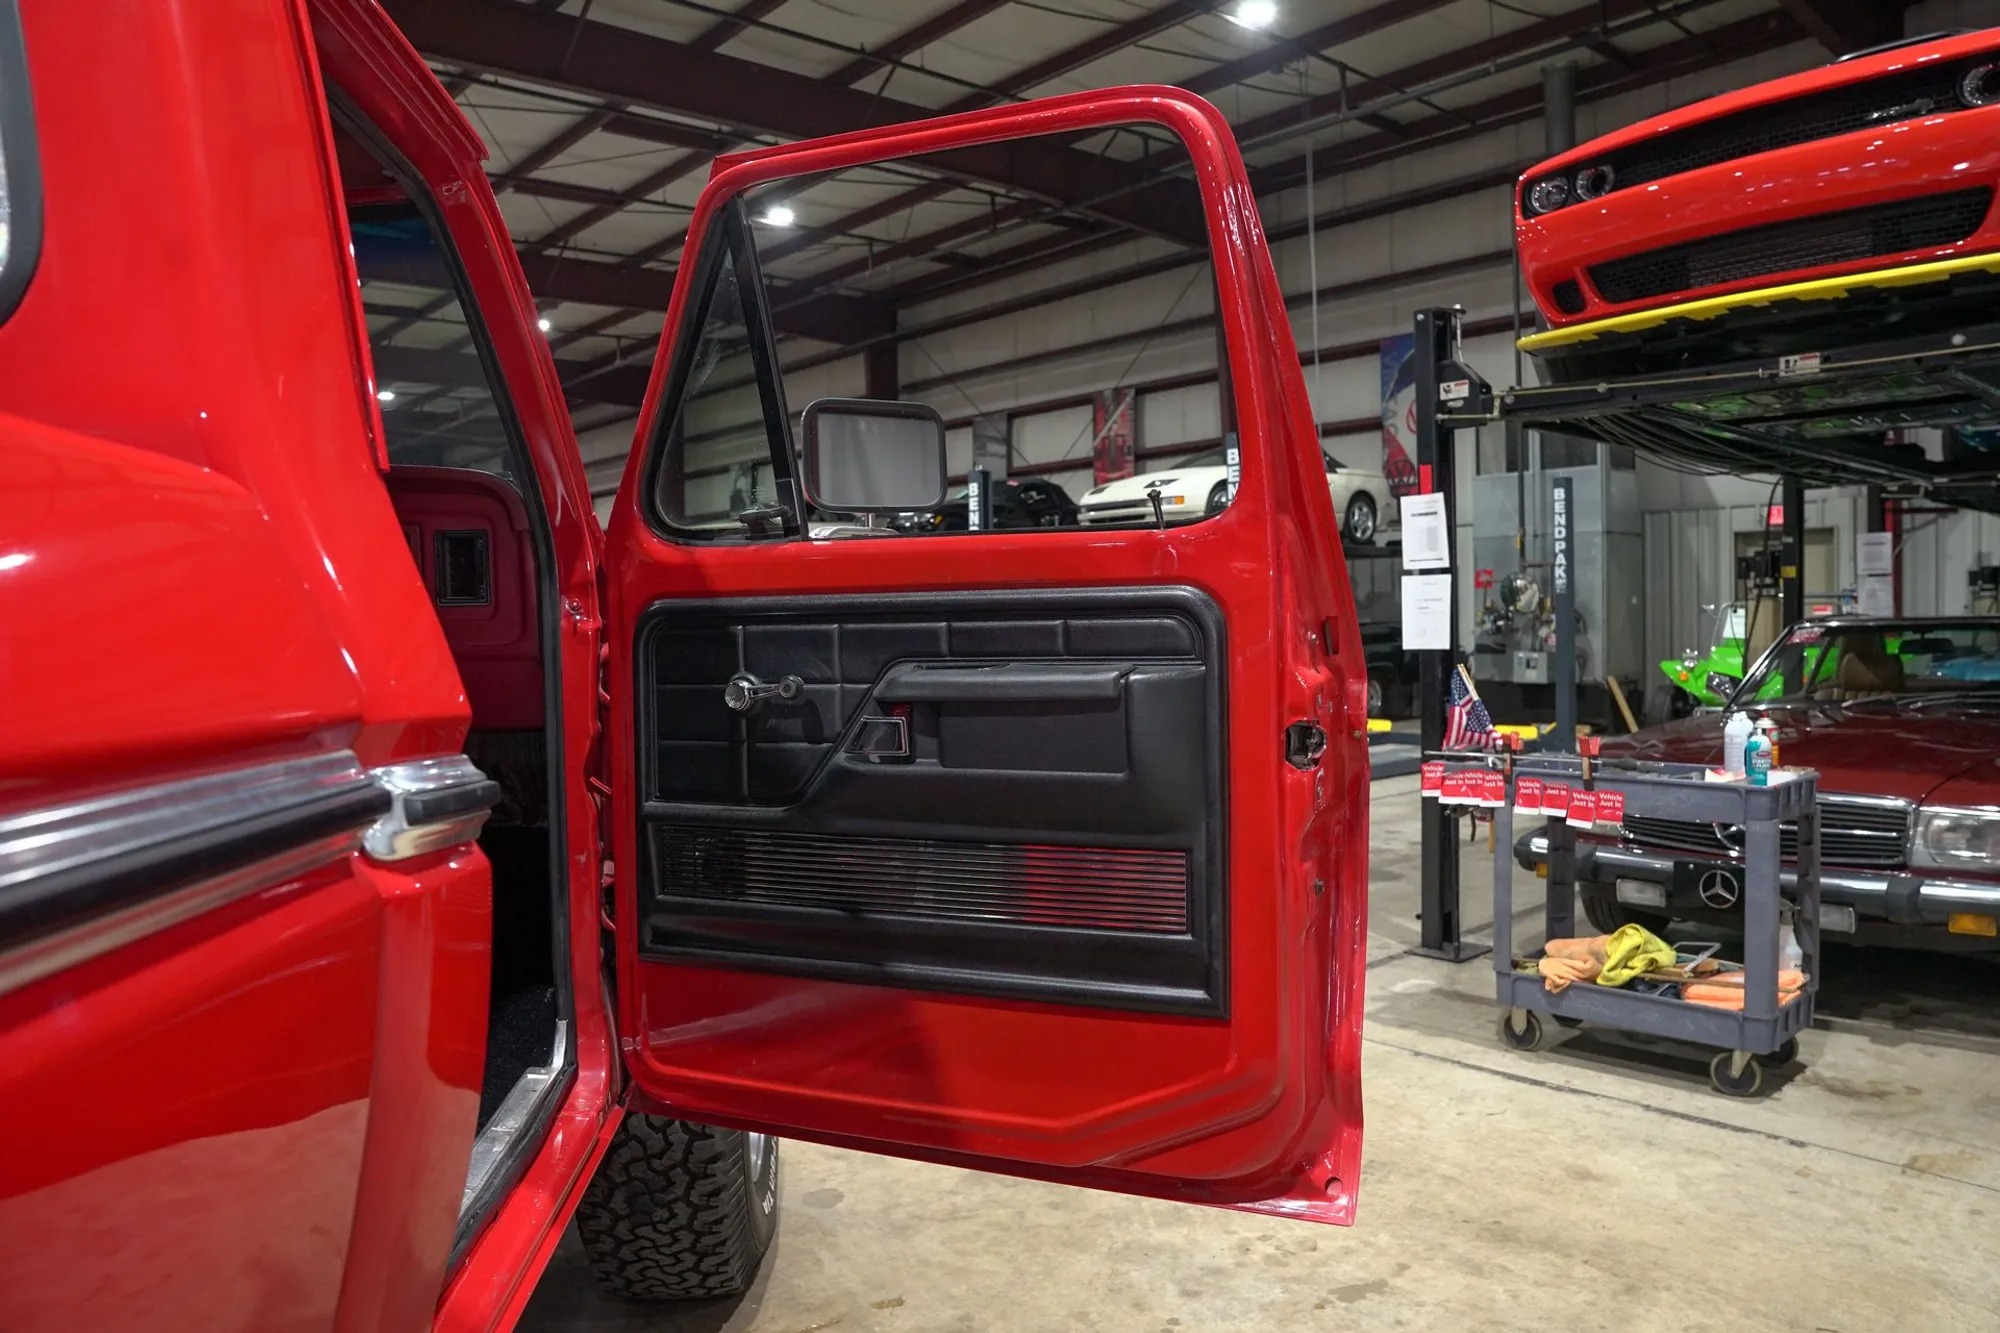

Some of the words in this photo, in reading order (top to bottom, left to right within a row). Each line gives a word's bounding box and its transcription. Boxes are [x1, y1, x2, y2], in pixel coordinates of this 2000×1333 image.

[1227, 448, 1240, 506] BEN
[1553, 487, 1567, 578] BENDPAK
[1572, 792, 1596, 802] Vehicle
[1599, 793, 1623, 801] Vehicle
